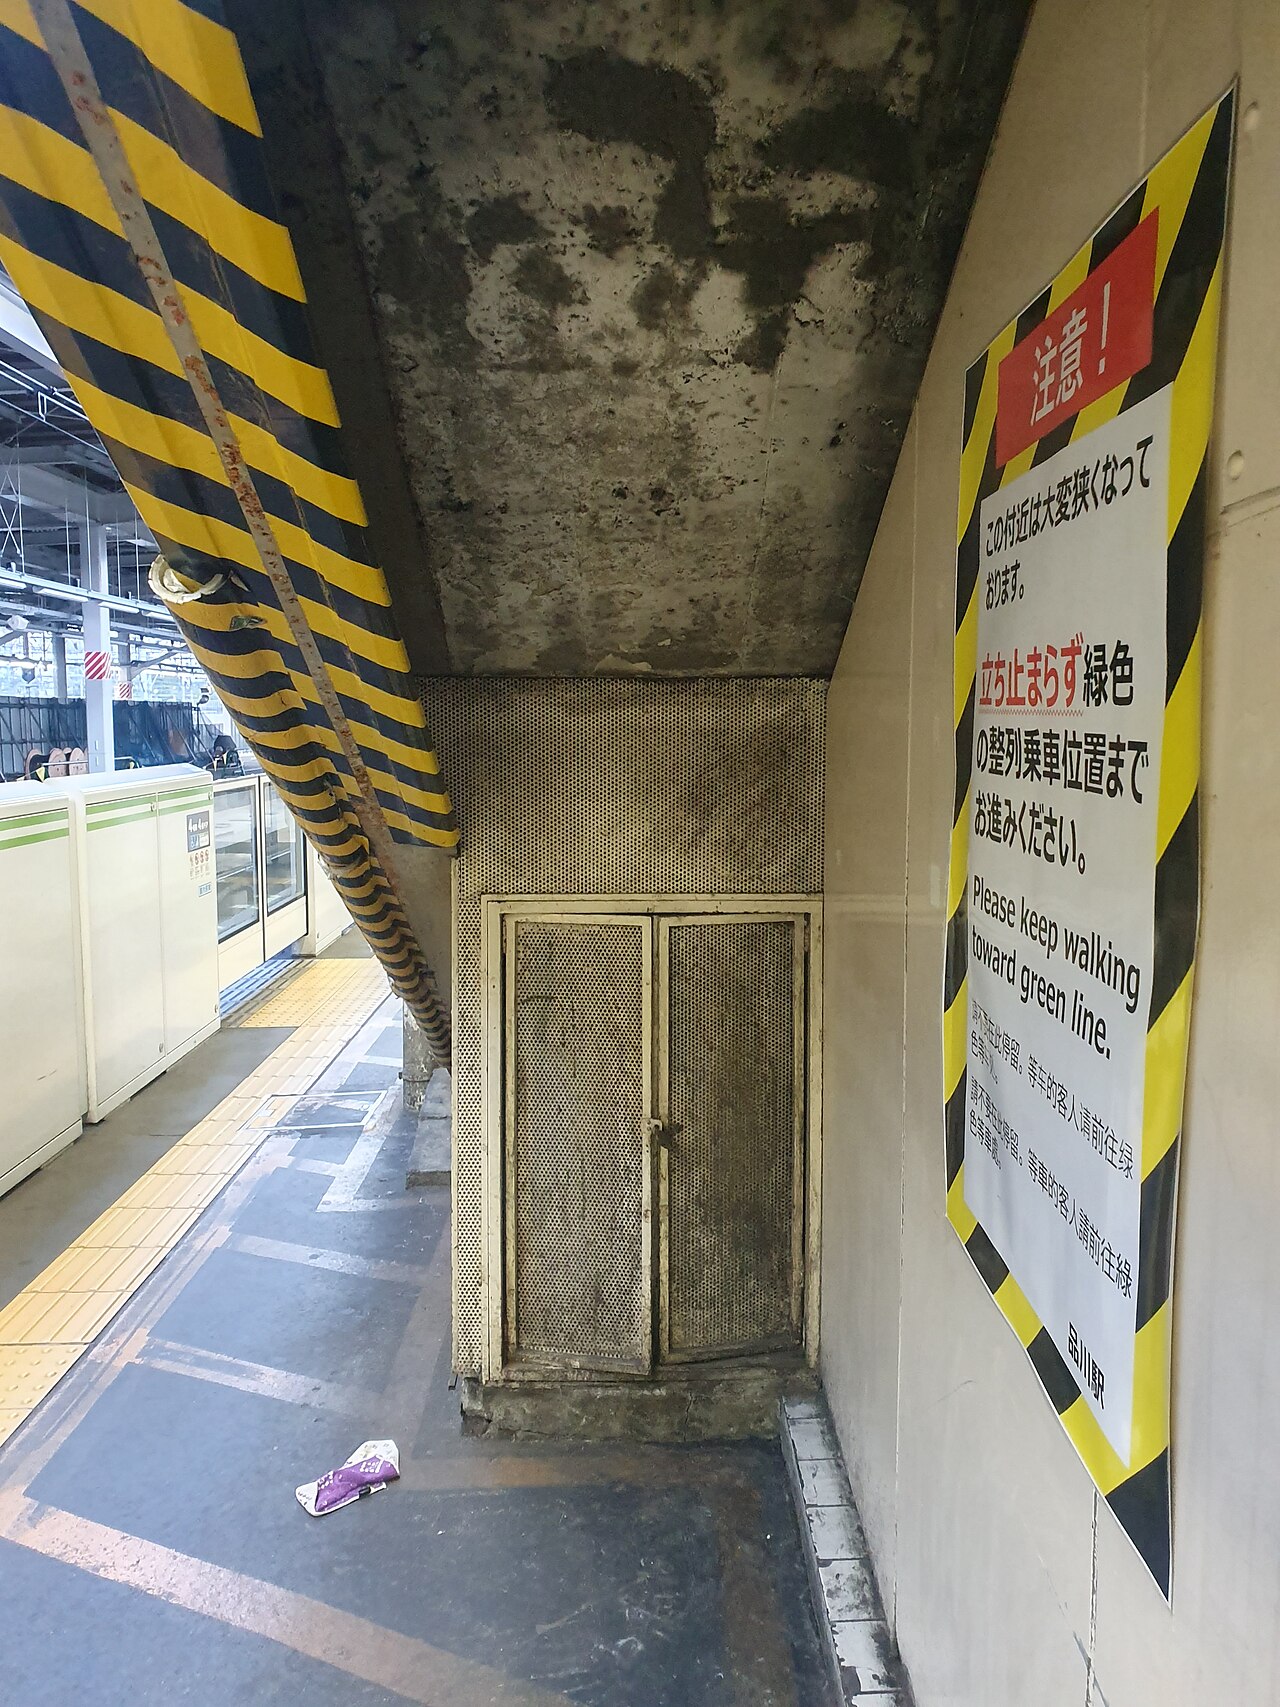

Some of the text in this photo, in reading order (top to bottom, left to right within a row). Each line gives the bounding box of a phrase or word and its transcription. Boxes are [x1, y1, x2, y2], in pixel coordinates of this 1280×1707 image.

[985, 435, 1154, 557] この付近は大変狭くなって
[985, 559, 1025, 611] おります。
[976, 725, 1150, 804] の整列乗車位置まで
[974, 788, 1086, 875] お進みください。
[973, 874, 1141, 1013] Please keep walking
[972, 924, 1112, 1060] toward green line.
[1067, 1321, 1105, 1410] 品川駅
